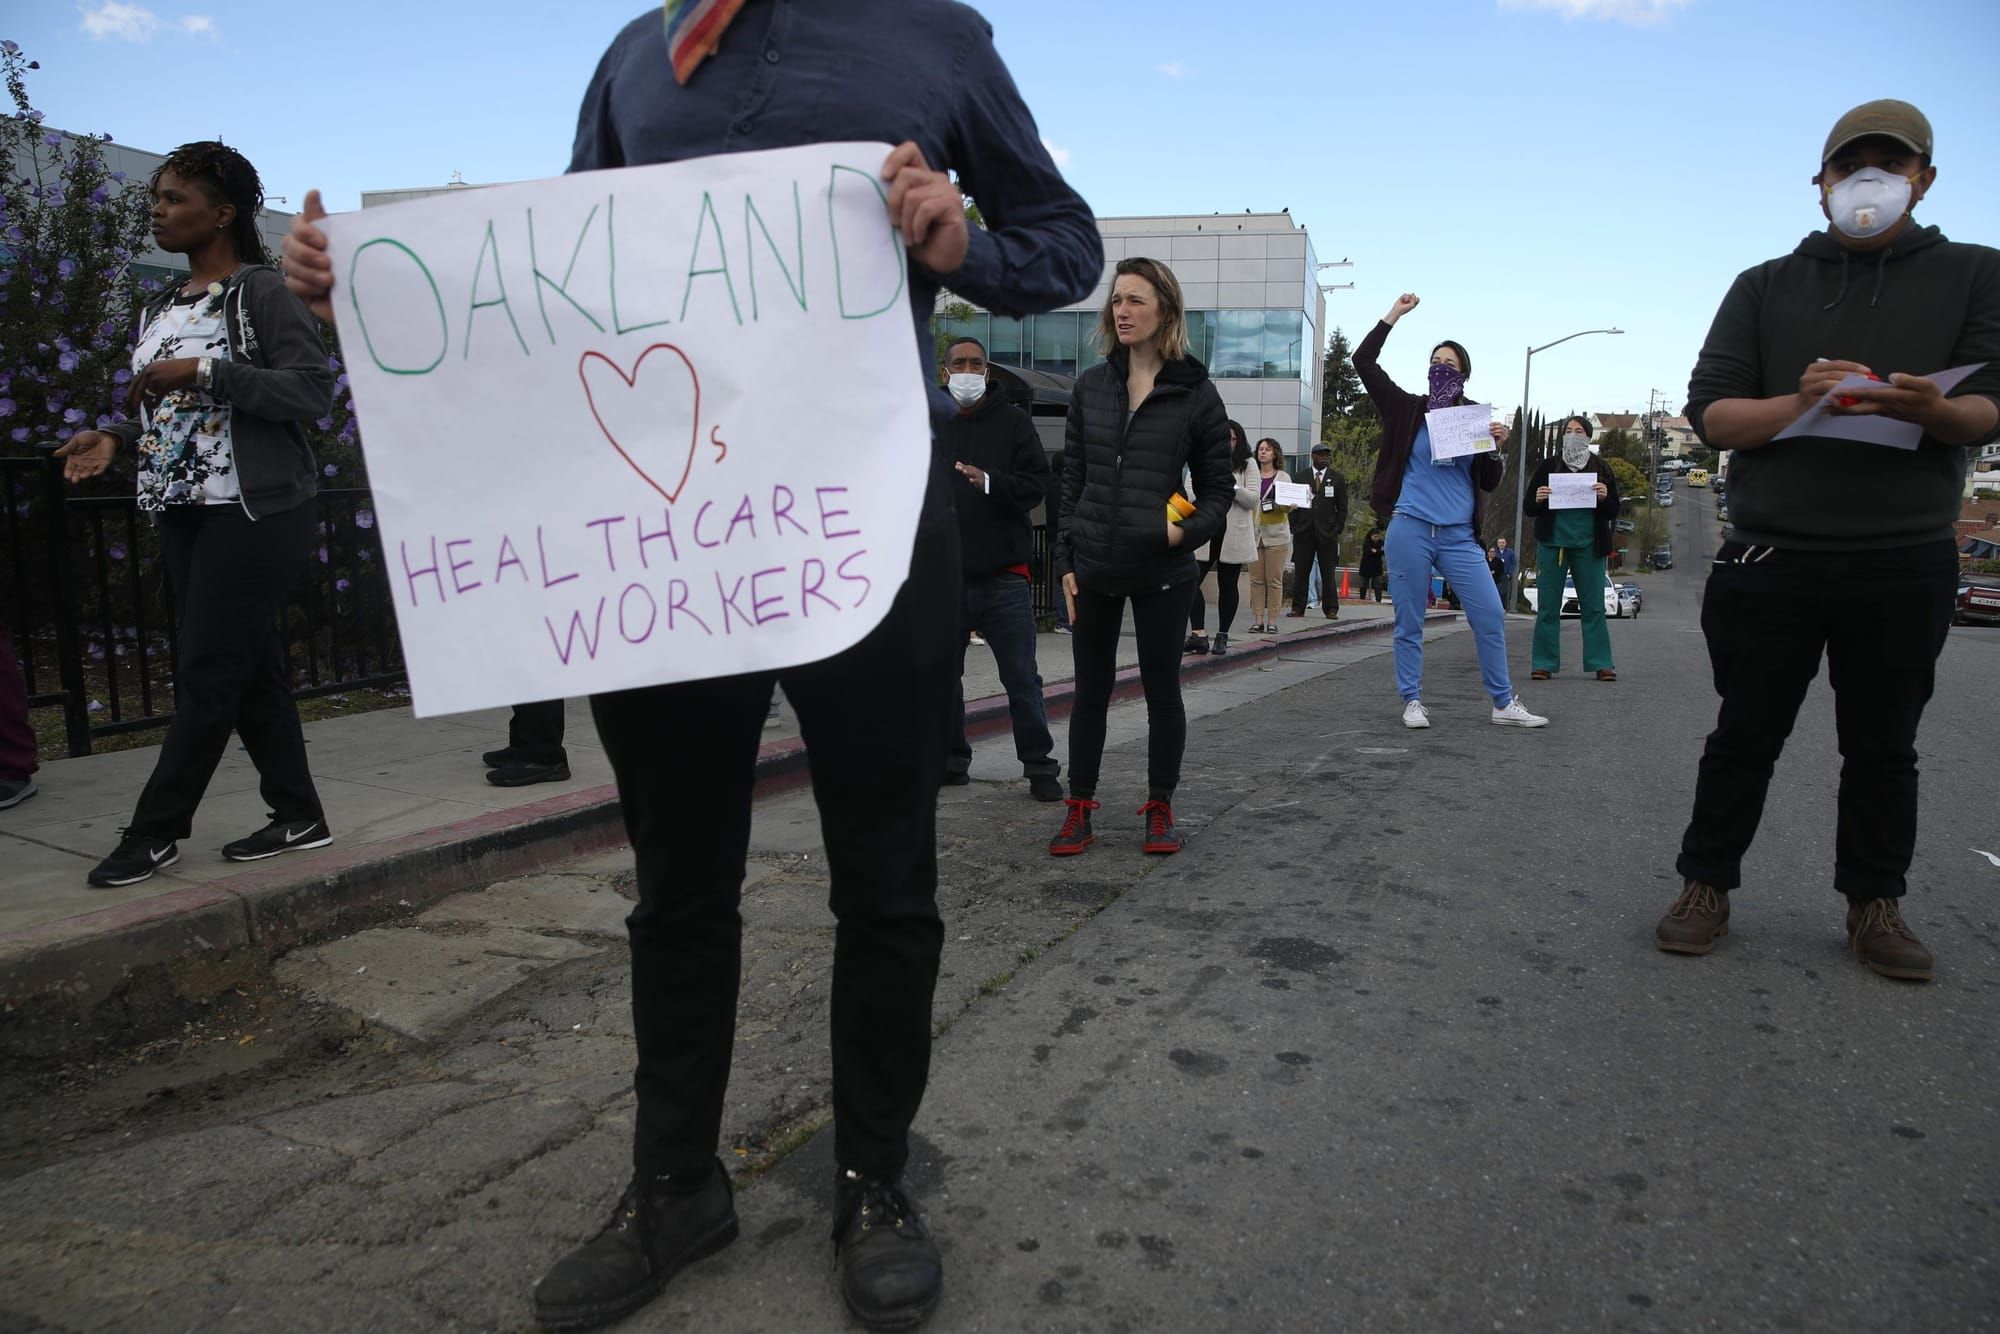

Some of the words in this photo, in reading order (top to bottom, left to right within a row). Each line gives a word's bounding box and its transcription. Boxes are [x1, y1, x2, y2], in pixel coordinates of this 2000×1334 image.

[351, 164, 904, 375] OAKLAND
[400, 485, 861, 607] HEALTHCARE
[545, 550, 871, 665] WORKERS
